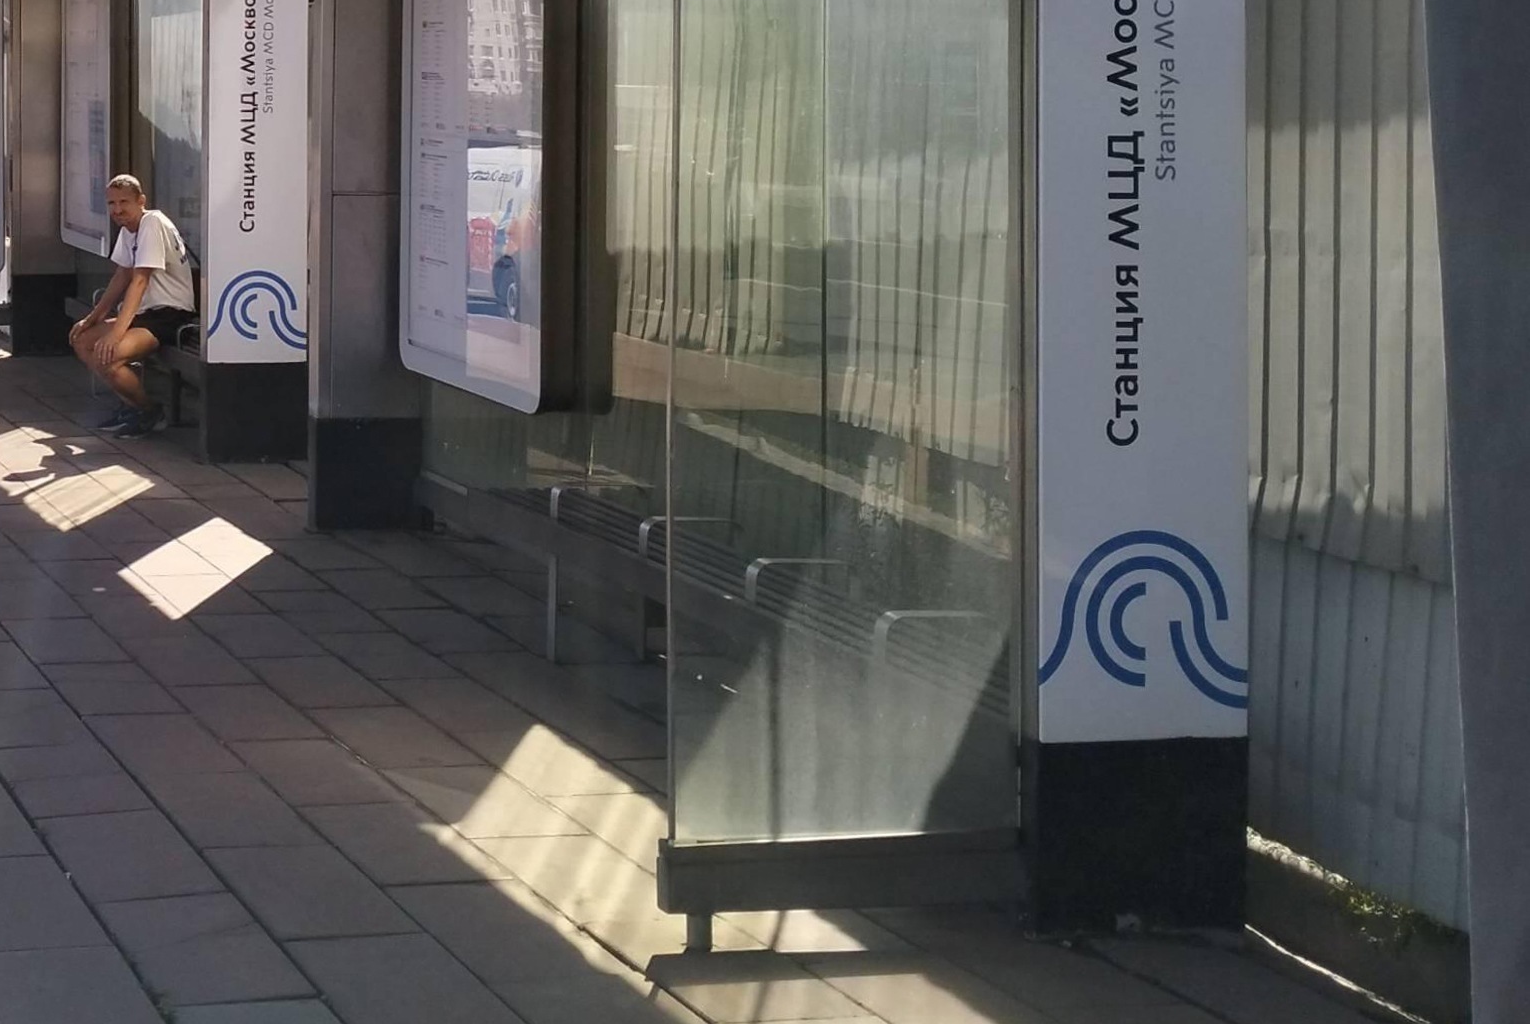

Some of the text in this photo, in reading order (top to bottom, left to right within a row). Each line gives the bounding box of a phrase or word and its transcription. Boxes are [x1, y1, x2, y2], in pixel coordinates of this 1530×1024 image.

[263, 22, 274, 55] MCD
[240, 91, 259, 145] МЦД
[262, 58, 275, 114] Stantsiya
[1154, 58, 1180, 181] Stantsiya
[239, 151, 257, 233] Станция
[1106, 130, 1147, 251] МЦД
[1105, 264, 1146, 447] Станция
